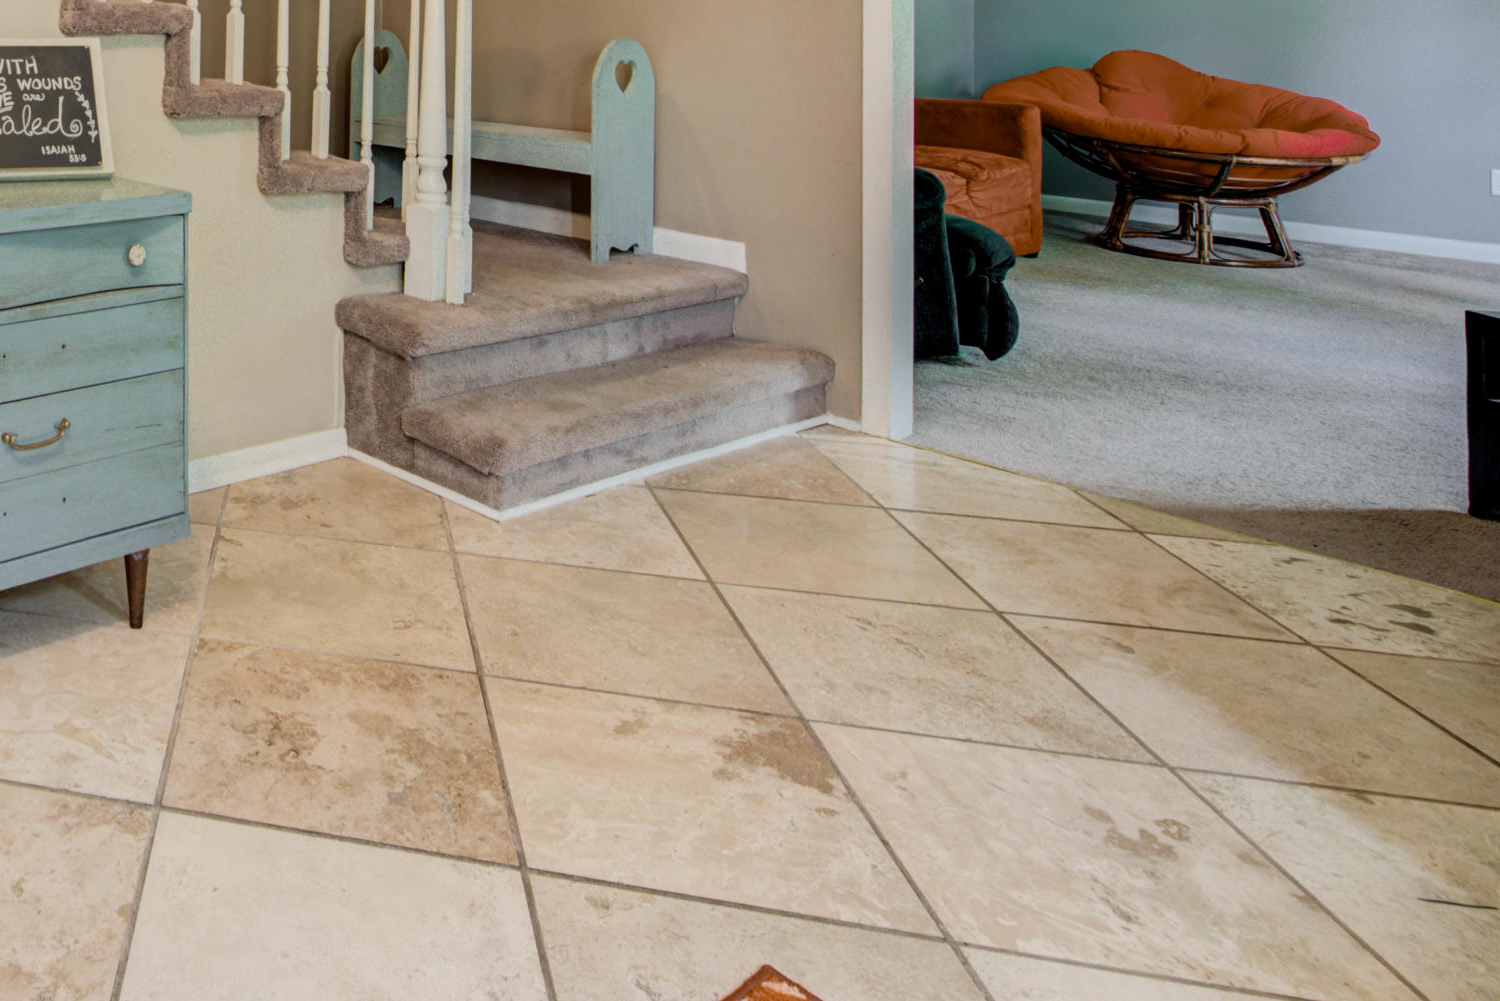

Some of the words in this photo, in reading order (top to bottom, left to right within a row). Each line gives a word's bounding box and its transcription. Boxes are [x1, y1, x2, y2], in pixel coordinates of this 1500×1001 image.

[16, 76, 82, 92] WOUNDS
[22, 92, 46, 102] are
[41, 144, 76, 156] ISAIAH
